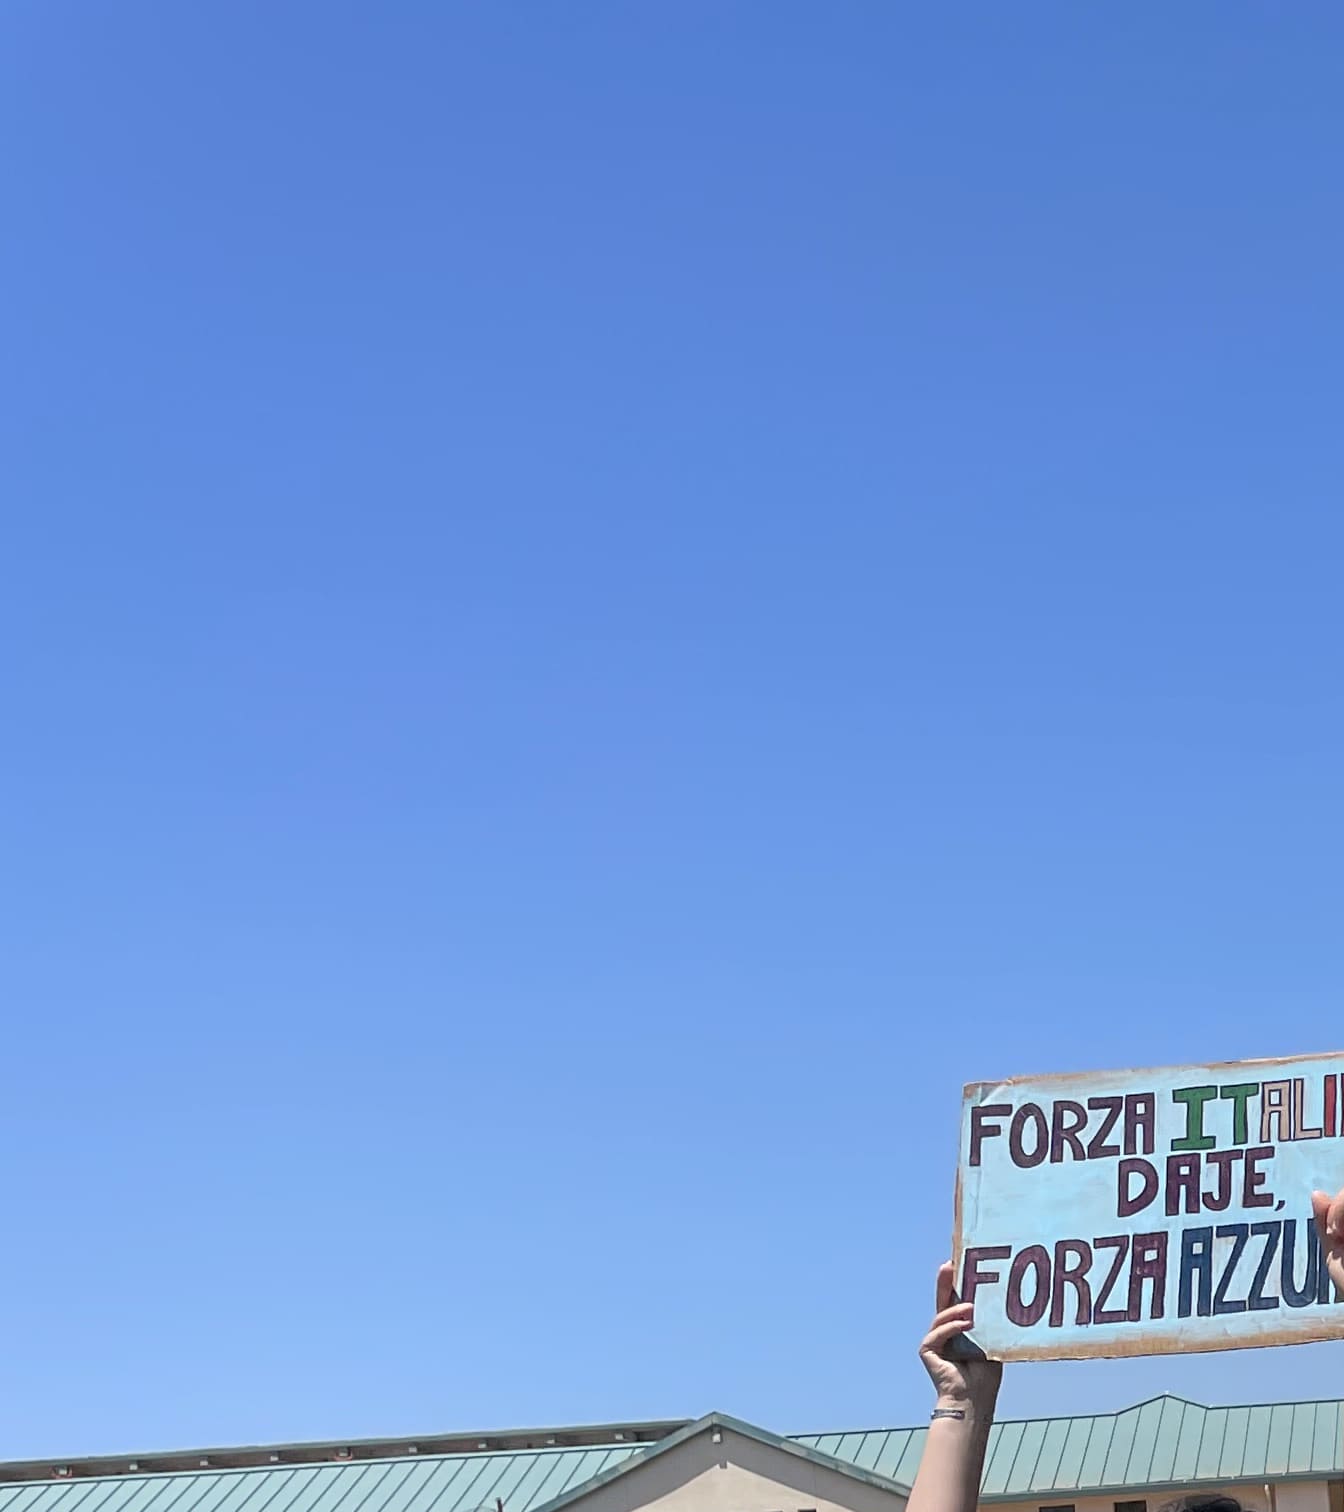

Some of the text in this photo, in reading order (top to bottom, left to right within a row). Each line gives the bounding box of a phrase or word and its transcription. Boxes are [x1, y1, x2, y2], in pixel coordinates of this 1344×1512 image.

[969, 1092, 1155, 1168] FORZA
[1118, 1146, 1286, 1218] DAJE,
[962, 1231, 1168, 1328] FORZA
